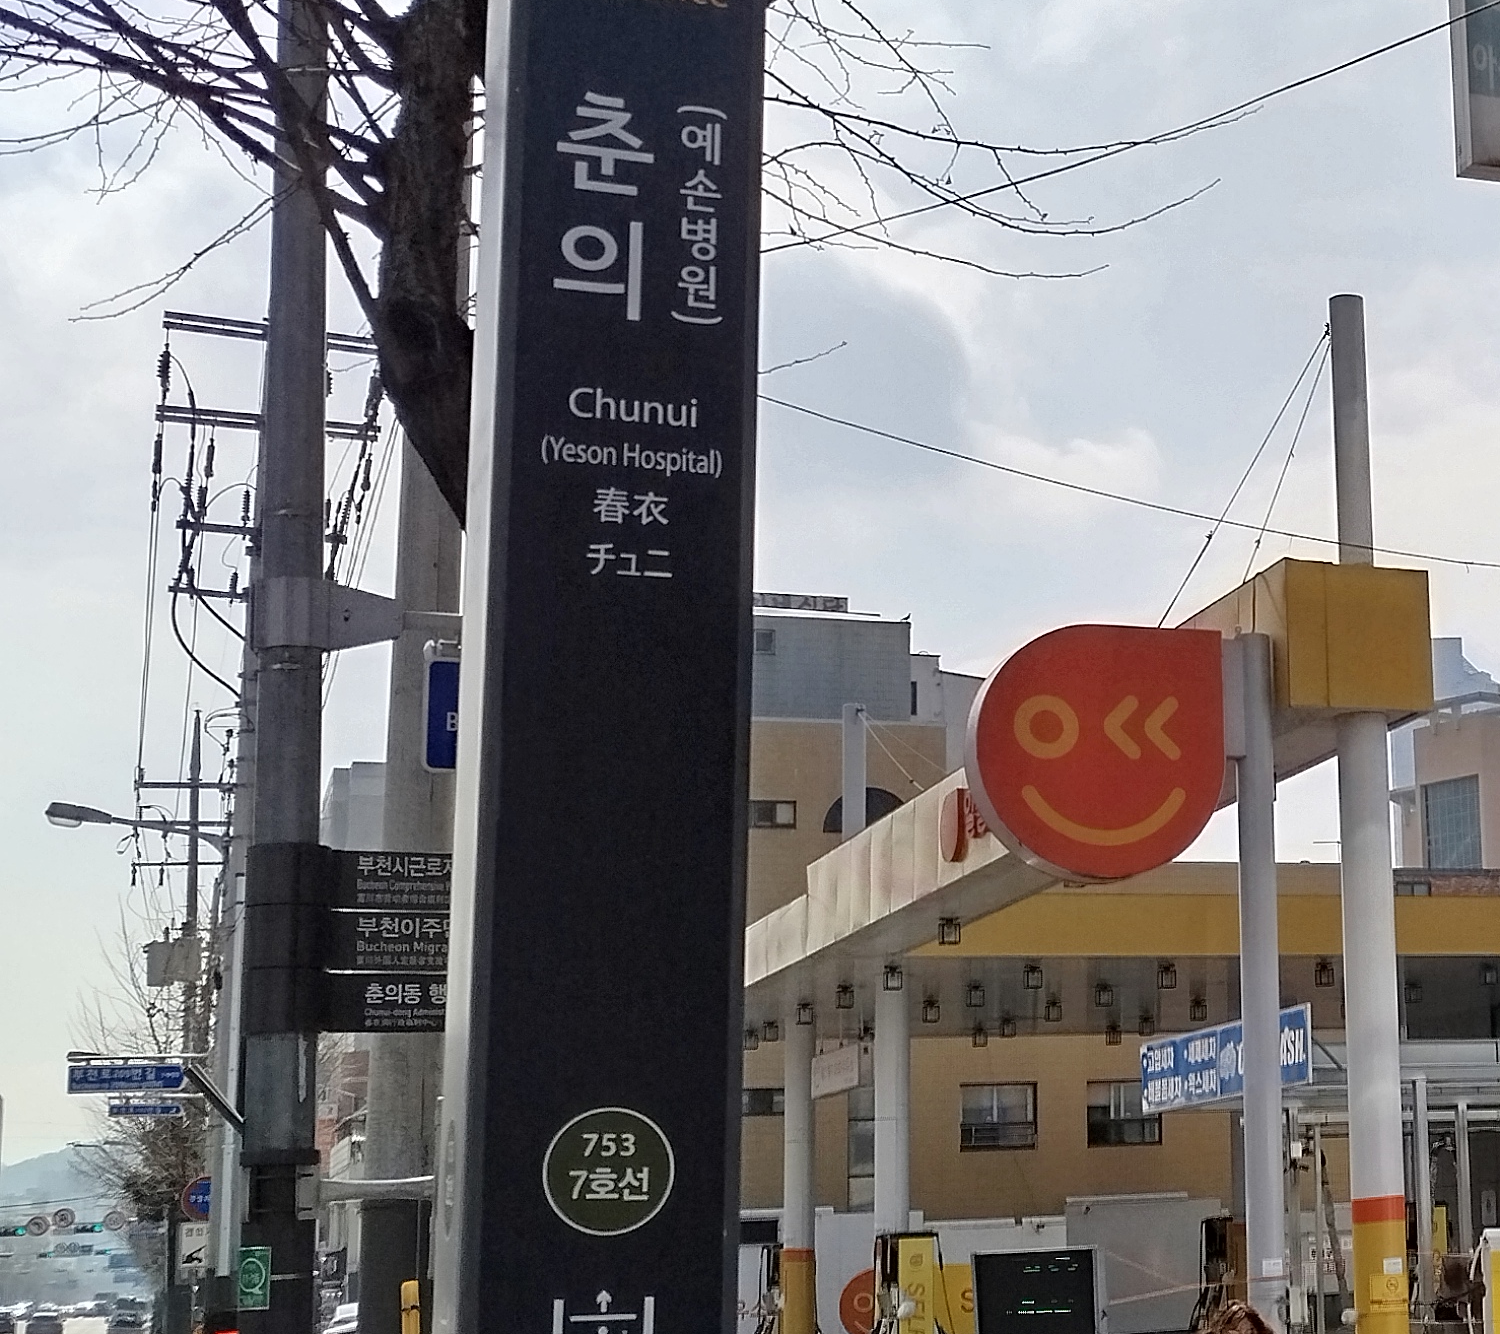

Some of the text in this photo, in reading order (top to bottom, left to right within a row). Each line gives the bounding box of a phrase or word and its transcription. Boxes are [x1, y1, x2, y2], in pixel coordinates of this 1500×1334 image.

[552, 90, 655, 322] 춘의
[670, 104, 728, 326] (예손병원)
[568, 387, 699, 429] Chunui
[540, 433, 723, 478] (Yeson Hospital)
[592, 487, 670, 526] 春衣
[585, 542, 673, 579] チュニ
[356, 940, 410, 953] Bucheon
[364, 983, 422, 1005] 춘의동
[581, 1132, 637, 1158] 753
[568, 1166, 651, 1201] 7호선
